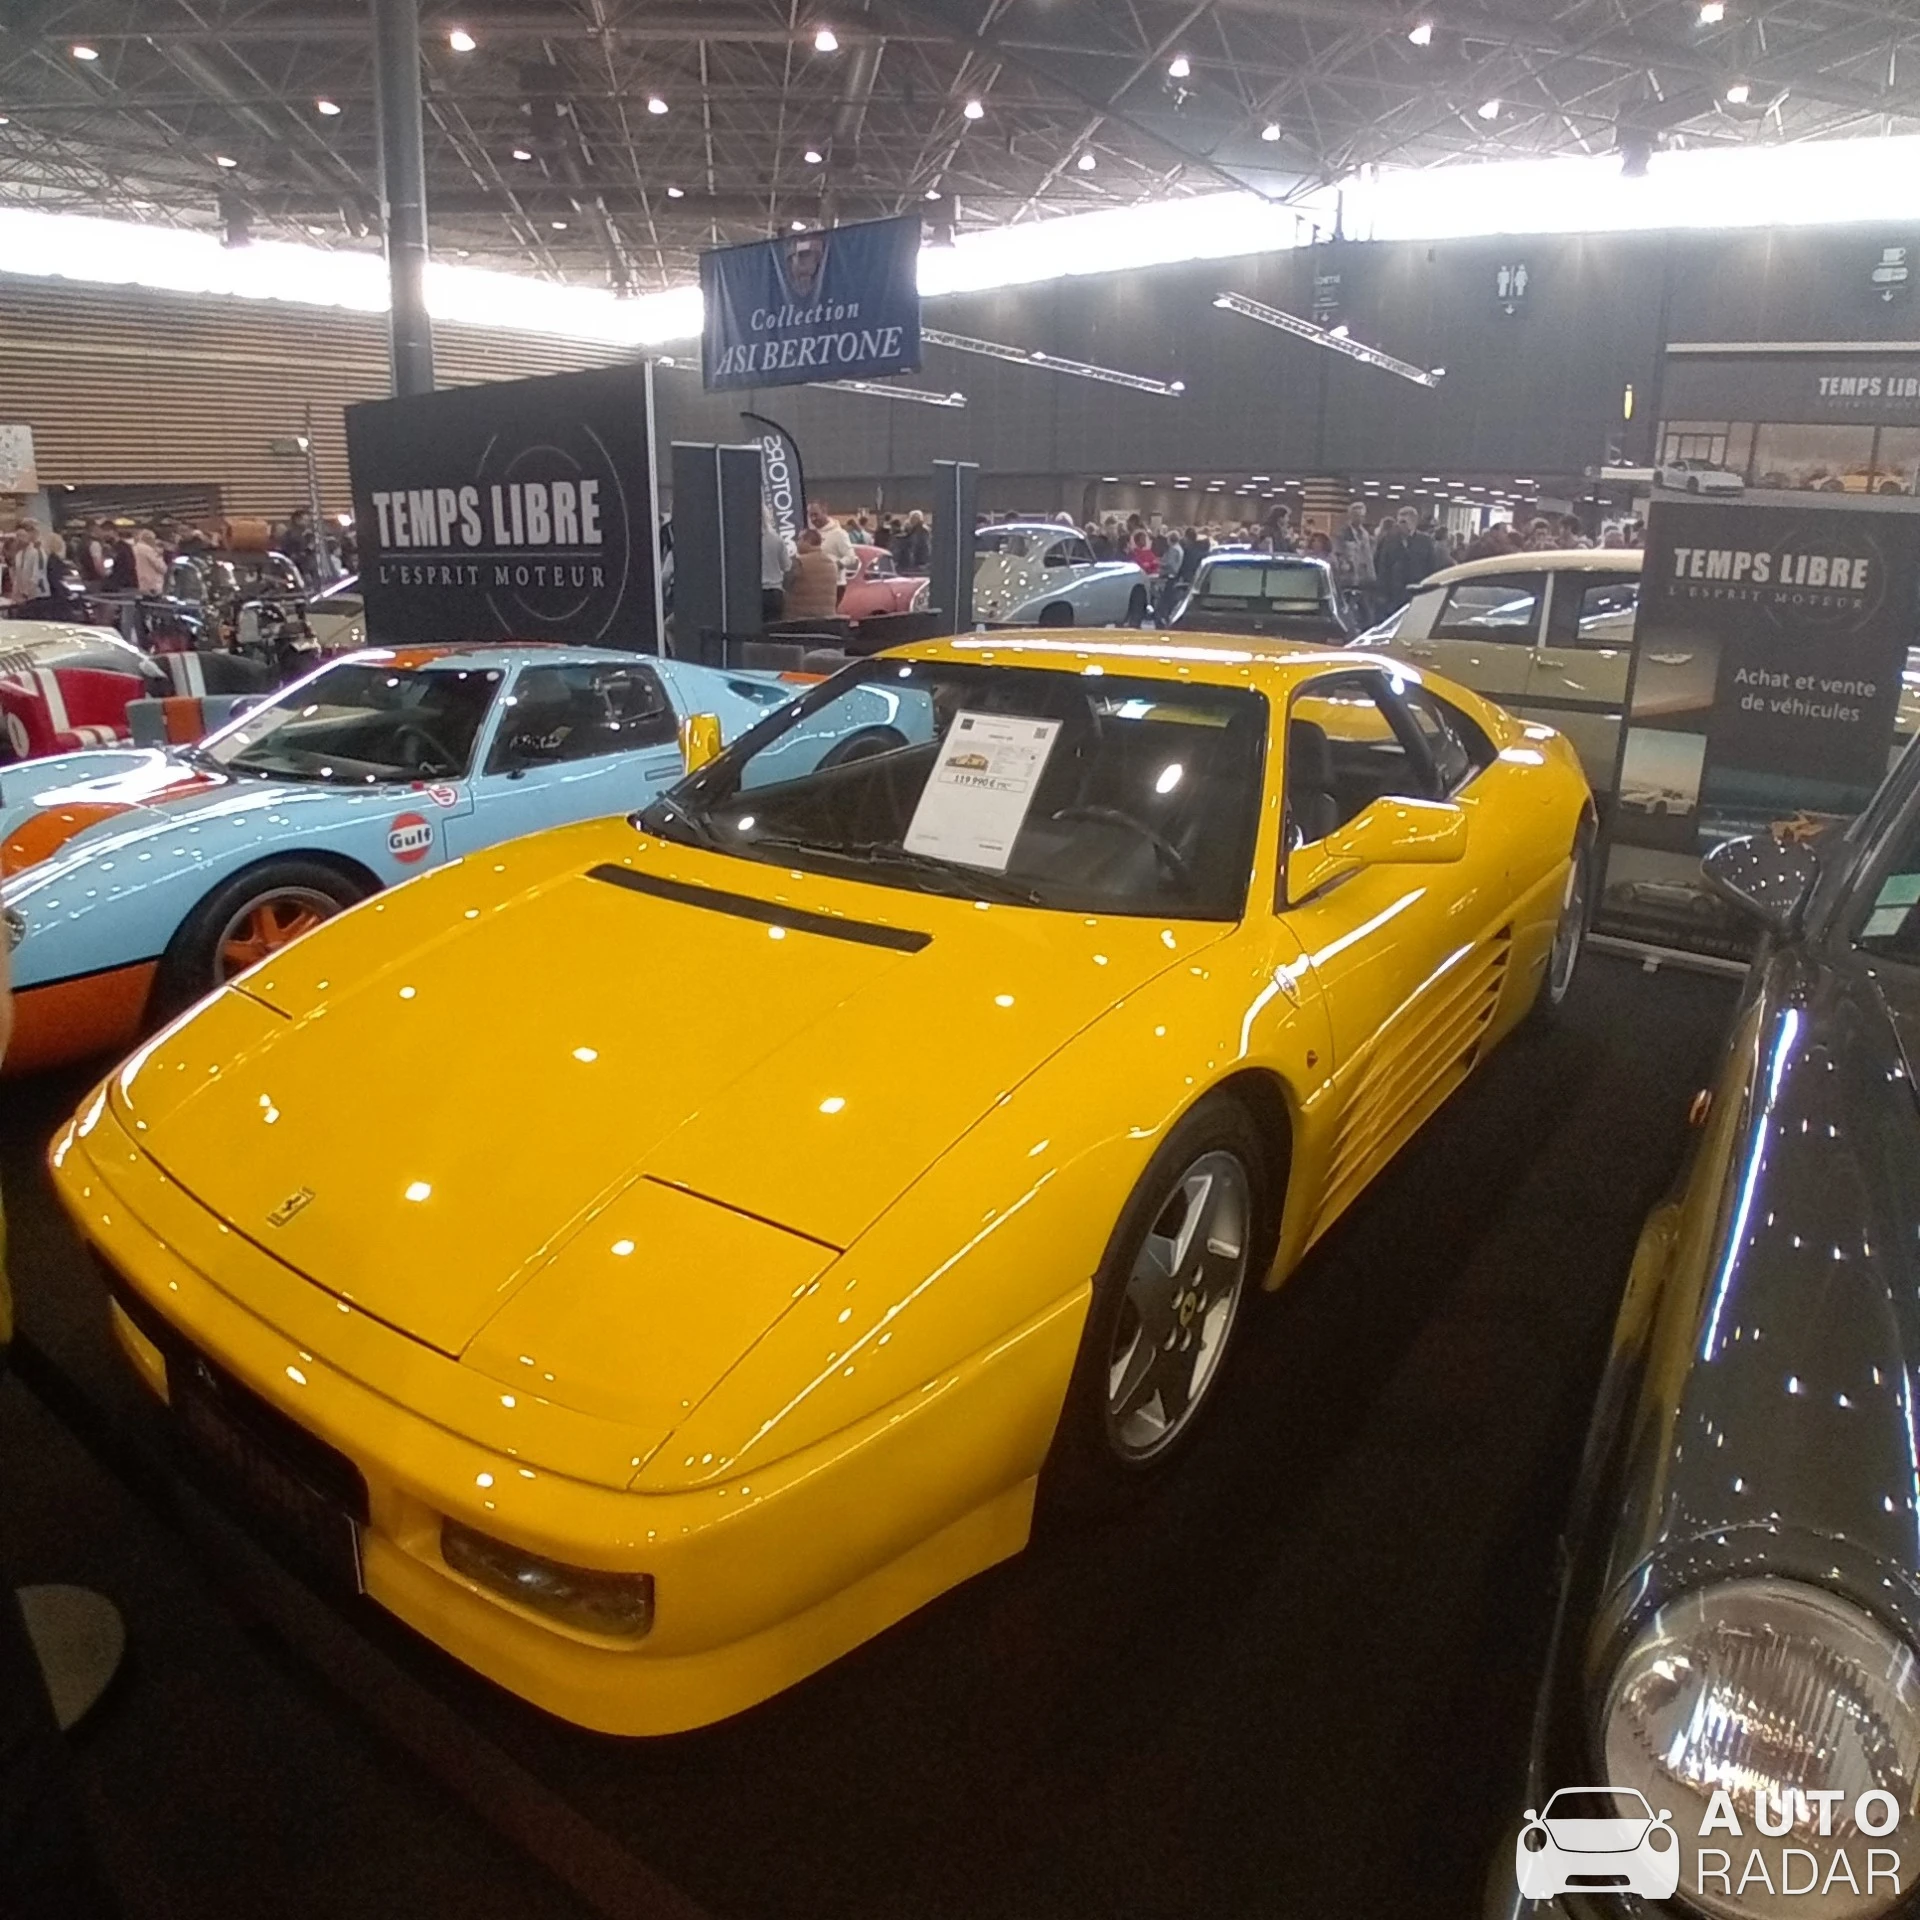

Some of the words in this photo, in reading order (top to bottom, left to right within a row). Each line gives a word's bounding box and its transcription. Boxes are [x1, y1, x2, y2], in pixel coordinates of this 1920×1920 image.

[750, 298, 860, 331] Collection
[715, 343, 757, 375] ASI
[760, 326, 903, 370] BERTONE
[1819, 376, 1882, 396] TEMPS
[1886, 377, 1920, 397] LIB
[372, 485, 483, 547] TEMPS
[490, 479, 602, 545] LIBRE
[379, 565, 479, 585] L'ESPRIT
[495, 565, 604, 587] MOTEUR
[1674, 548, 1772, 582] TEMPS
[1779, 554, 1869, 589] LIBRE
[1774, 592, 1863, 609] MOTEUR
[1734, 668, 1790, 689] Achat
[1795, 675, 1815, 691] et
[1820, 678, 1877, 698] vente
[1740, 693, 1765, 711] de
[1770, 697, 1861, 722] véhicules
[389, 827, 431, 849] Gulf
